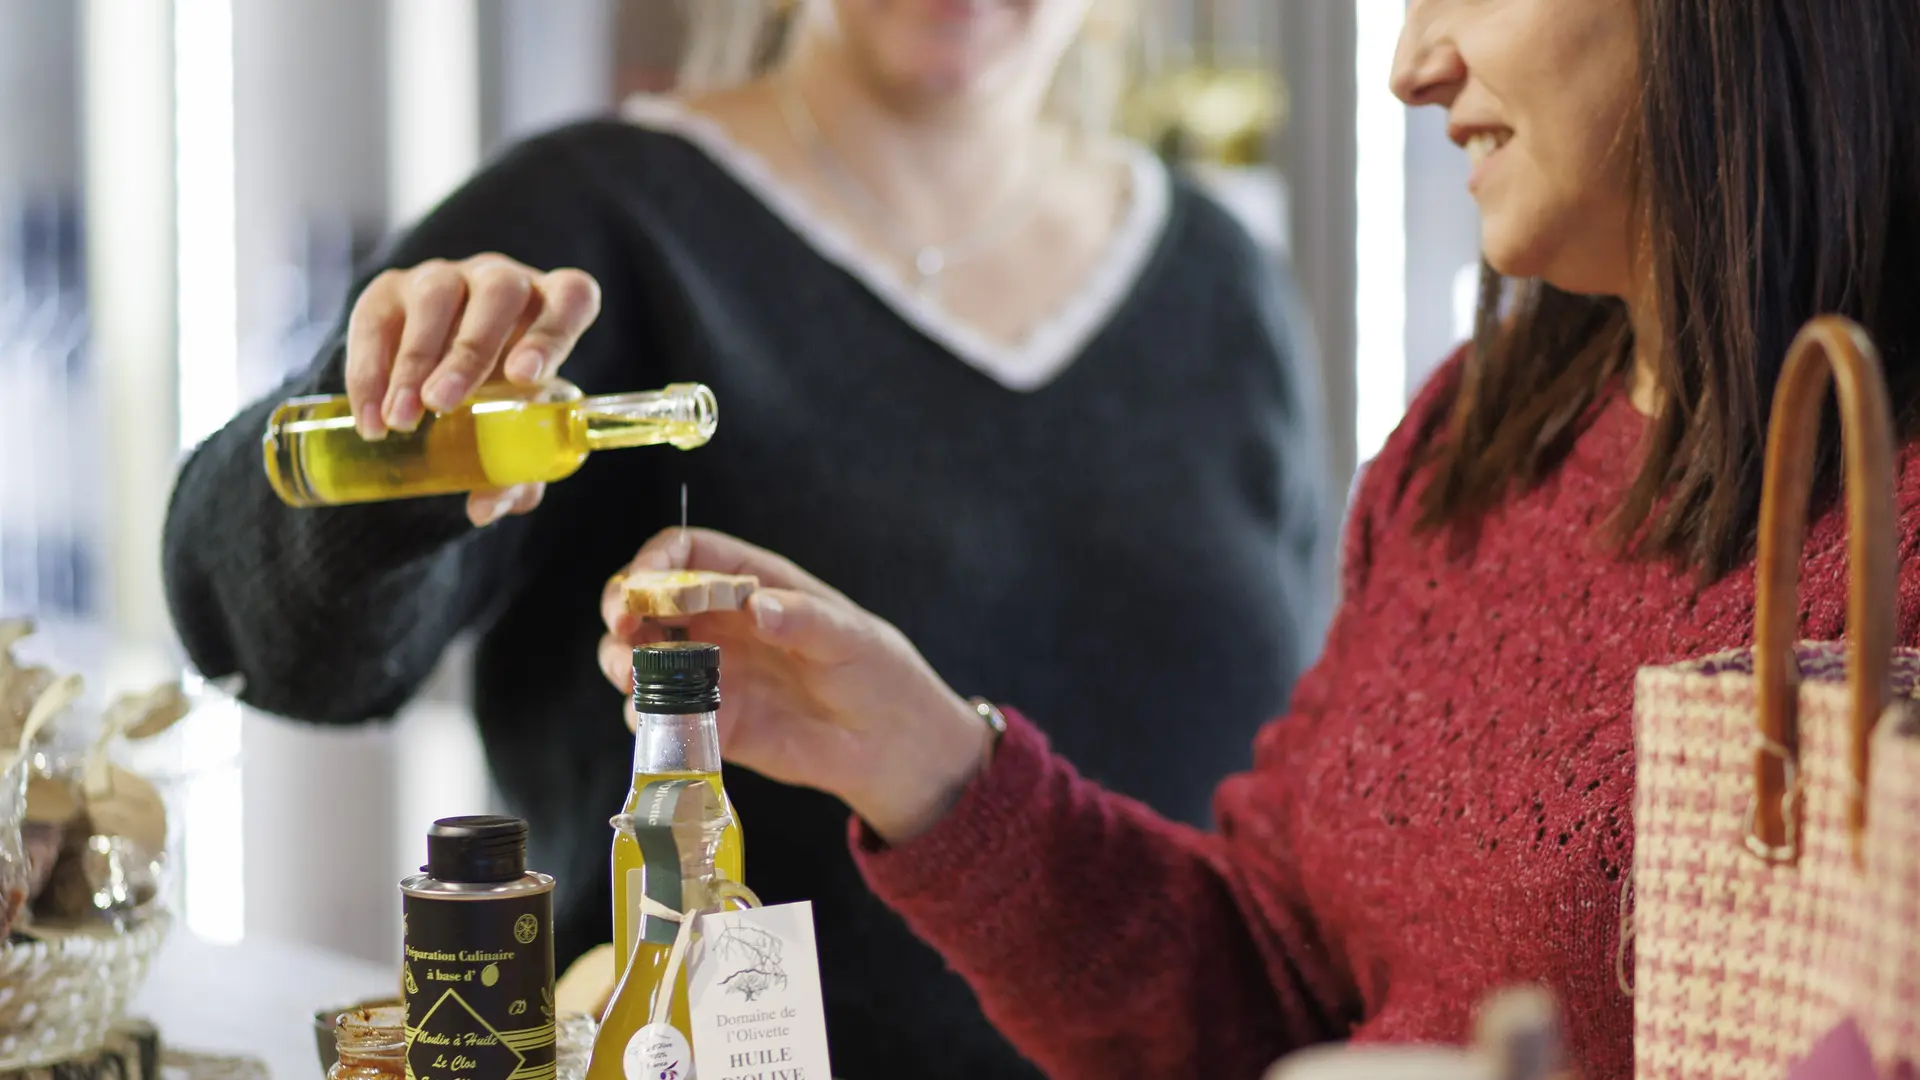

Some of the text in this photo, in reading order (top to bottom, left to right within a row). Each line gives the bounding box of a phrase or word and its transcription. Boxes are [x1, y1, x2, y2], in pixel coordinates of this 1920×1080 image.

[459, 949, 515, 961] Culinaire
[427, 968, 434, 980] à
[436, 968, 462, 981] base
[716, 1006, 796, 1027] Domaine de
[417, 1030, 498, 1046] Moulin à Huile
[726, 1026, 790, 1043] l'Olivette
[431, 1054, 477, 1072] Le Clos
[729, 1047, 793, 1068] HUILE
